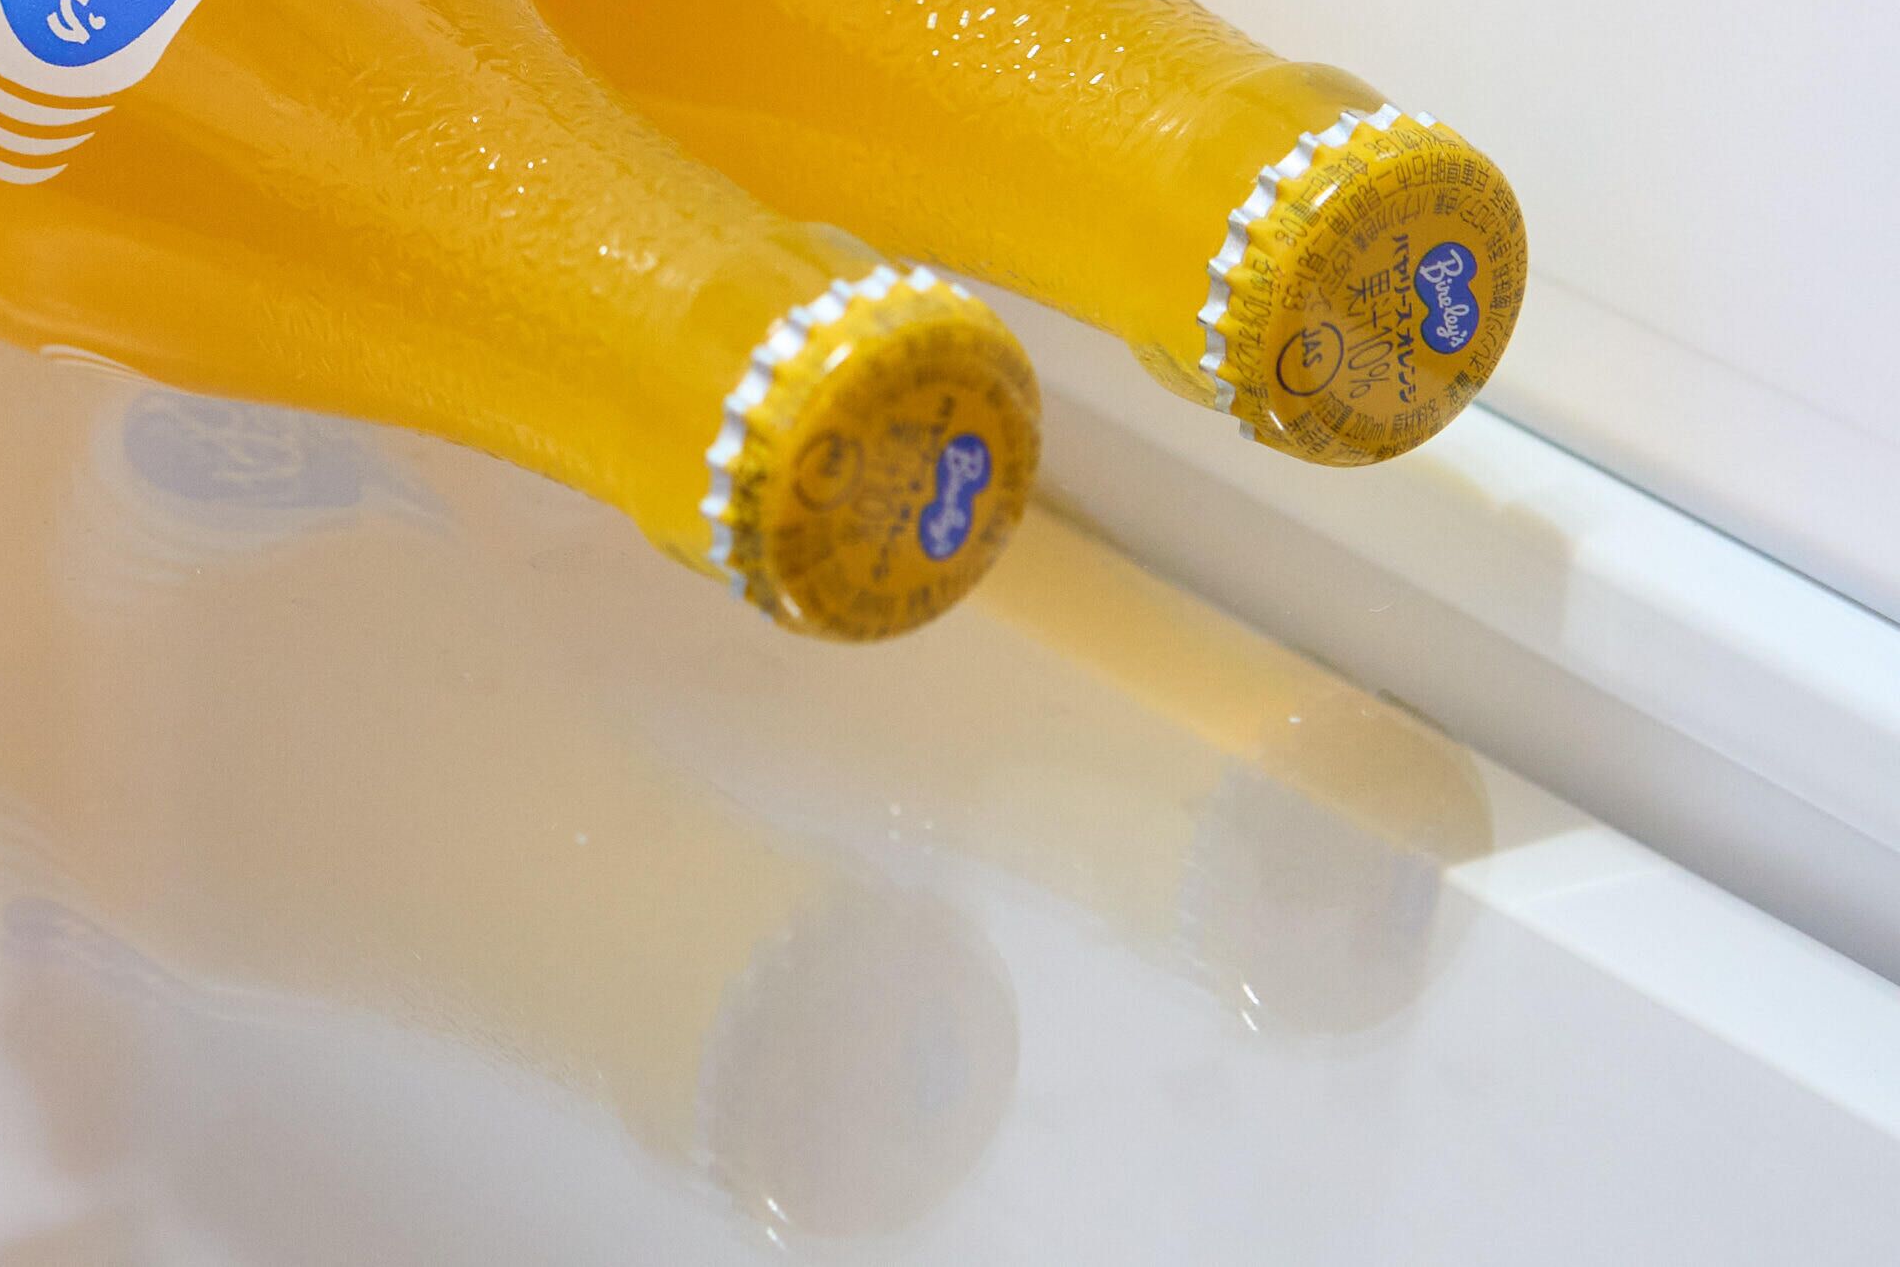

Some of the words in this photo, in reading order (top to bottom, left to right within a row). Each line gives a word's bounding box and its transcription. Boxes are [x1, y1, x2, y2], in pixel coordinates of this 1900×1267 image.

[1301, 327, 1322, 369] JAS
[1347, 269, 1394, 399] 果汁10%
[1419, 248, 1470, 349] Bireley's
